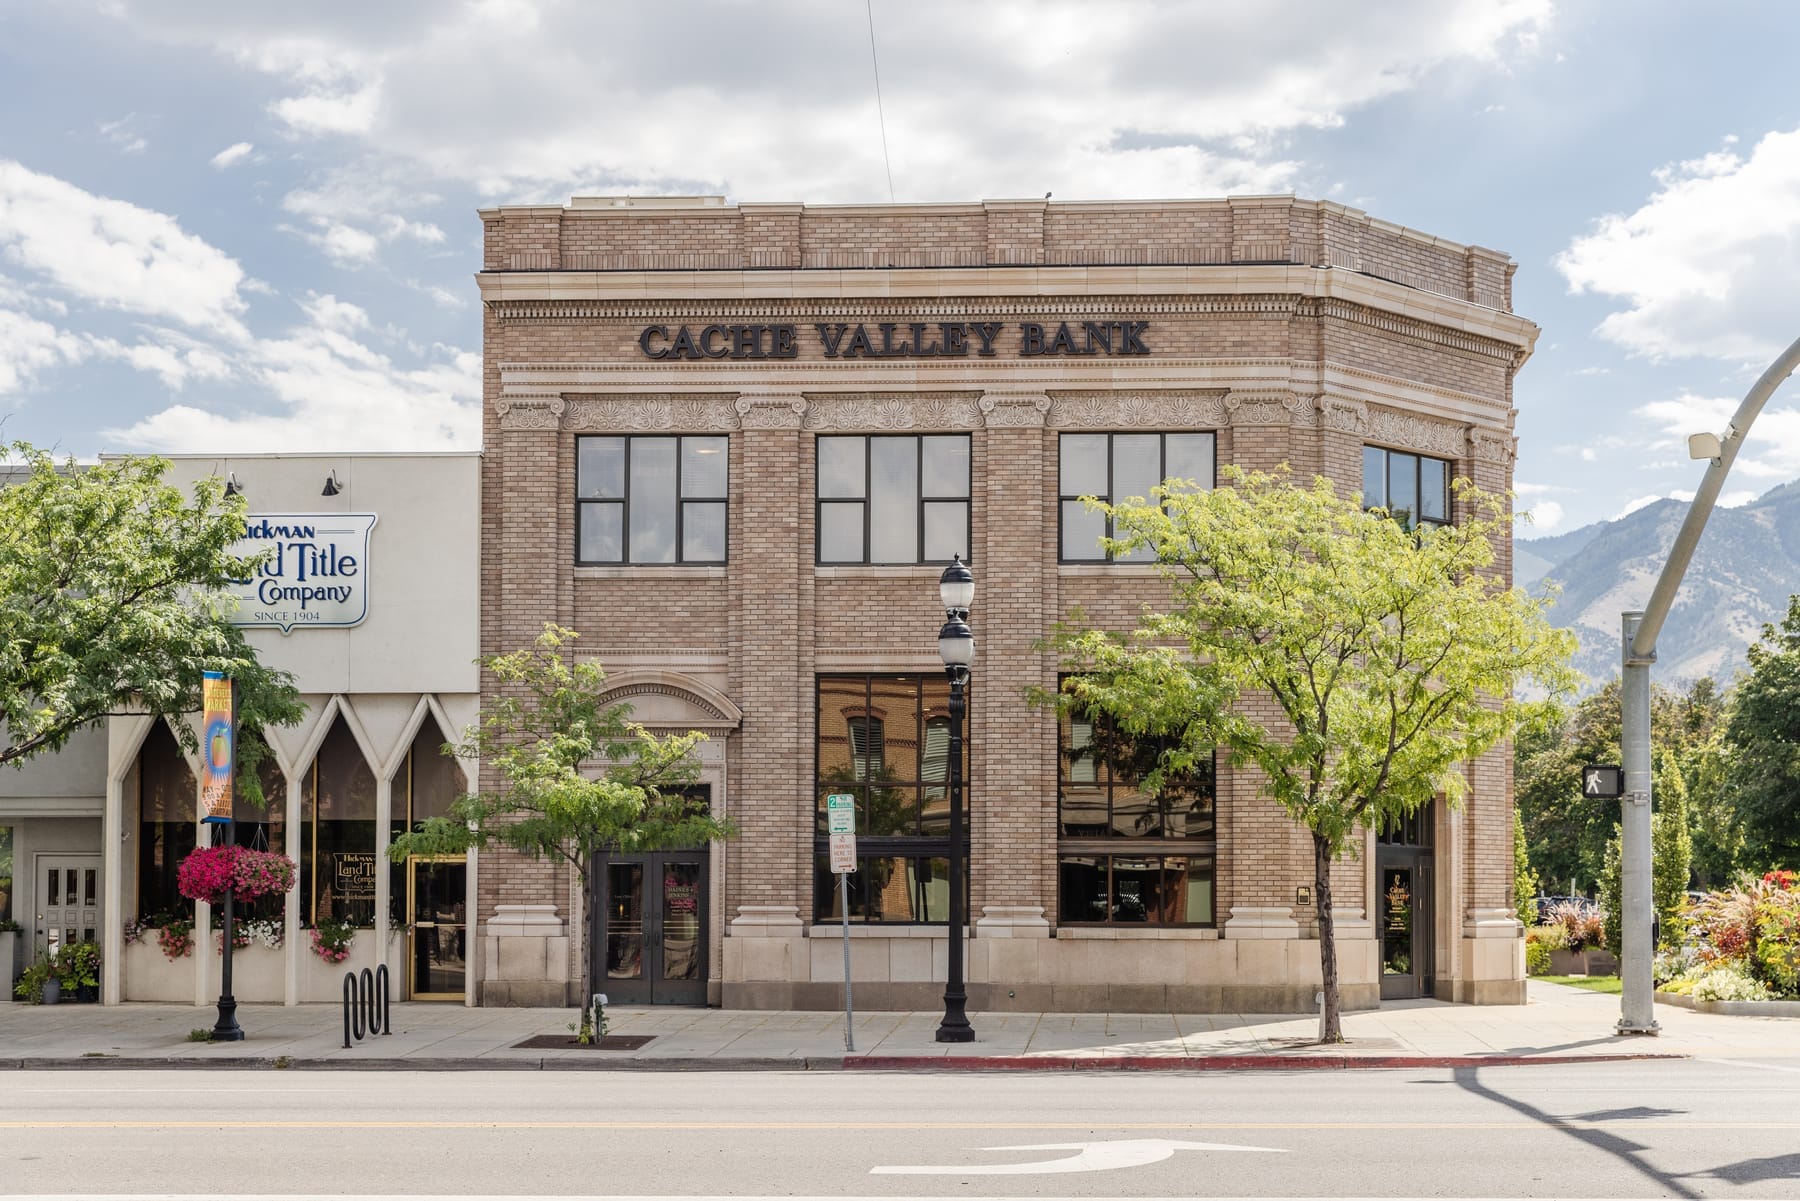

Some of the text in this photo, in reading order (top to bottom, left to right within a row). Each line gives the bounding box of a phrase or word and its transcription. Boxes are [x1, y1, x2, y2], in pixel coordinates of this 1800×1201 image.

[639, 321, 1150, 360] CACHE VALLEY BANK
[287, 543, 358, 582] Title
[258, 579, 352, 610] Company
[254, 611, 320, 621] SINCE 1904
[829, 797, 836, 808] 2
[338, 861, 363, 877] Land
[353, 874, 376, 886] Compa
